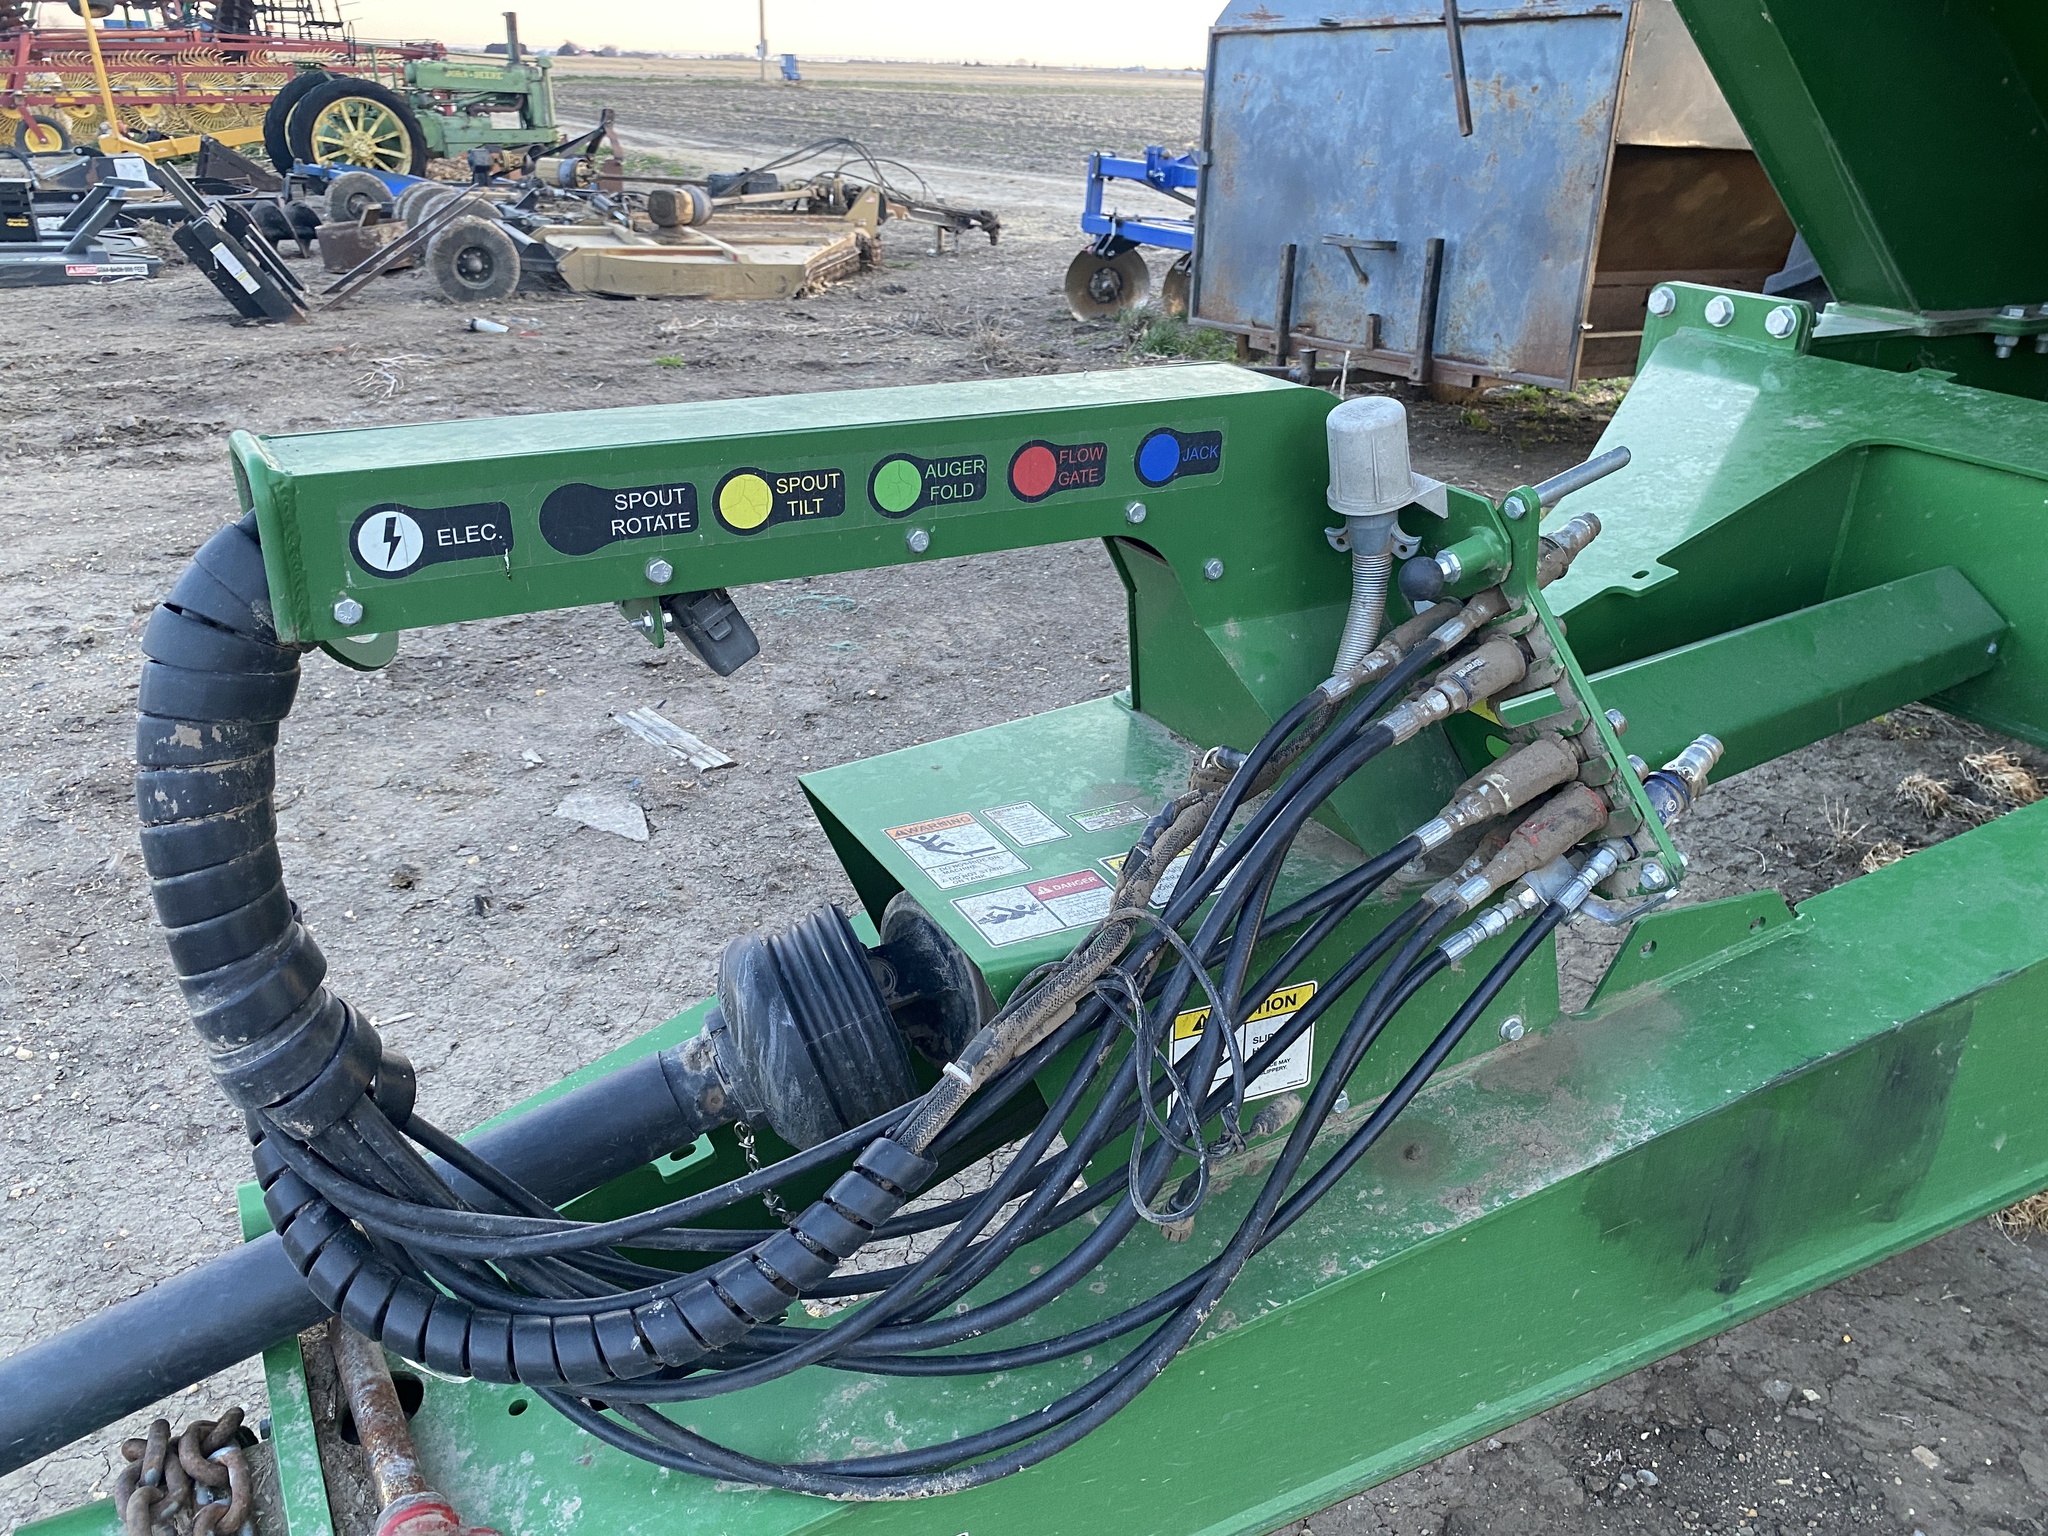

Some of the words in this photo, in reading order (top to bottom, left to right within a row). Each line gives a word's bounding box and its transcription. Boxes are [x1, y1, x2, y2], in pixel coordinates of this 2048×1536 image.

[1059, 445, 1104, 464] FLOW
[1182, 444, 1220, 463] JACK
[925, 459, 986, 480] AUGER
[1058, 467, 1099, 487] GATE
[776, 472, 841, 495] SPOUT
[930, 481, 975, 502] FOLD
[614, 487, 686, 511] SPOUT
[787, 498, 825, 517] TILT
[611, 511, 692, 536] ROTATE
[437, 523, 503, 547] ELEC.
[906, 815, 972, 836] WARNING
[1052, 876, 1098, 891] DANGER
[1278, 1057, 1292, 1065] MAY
